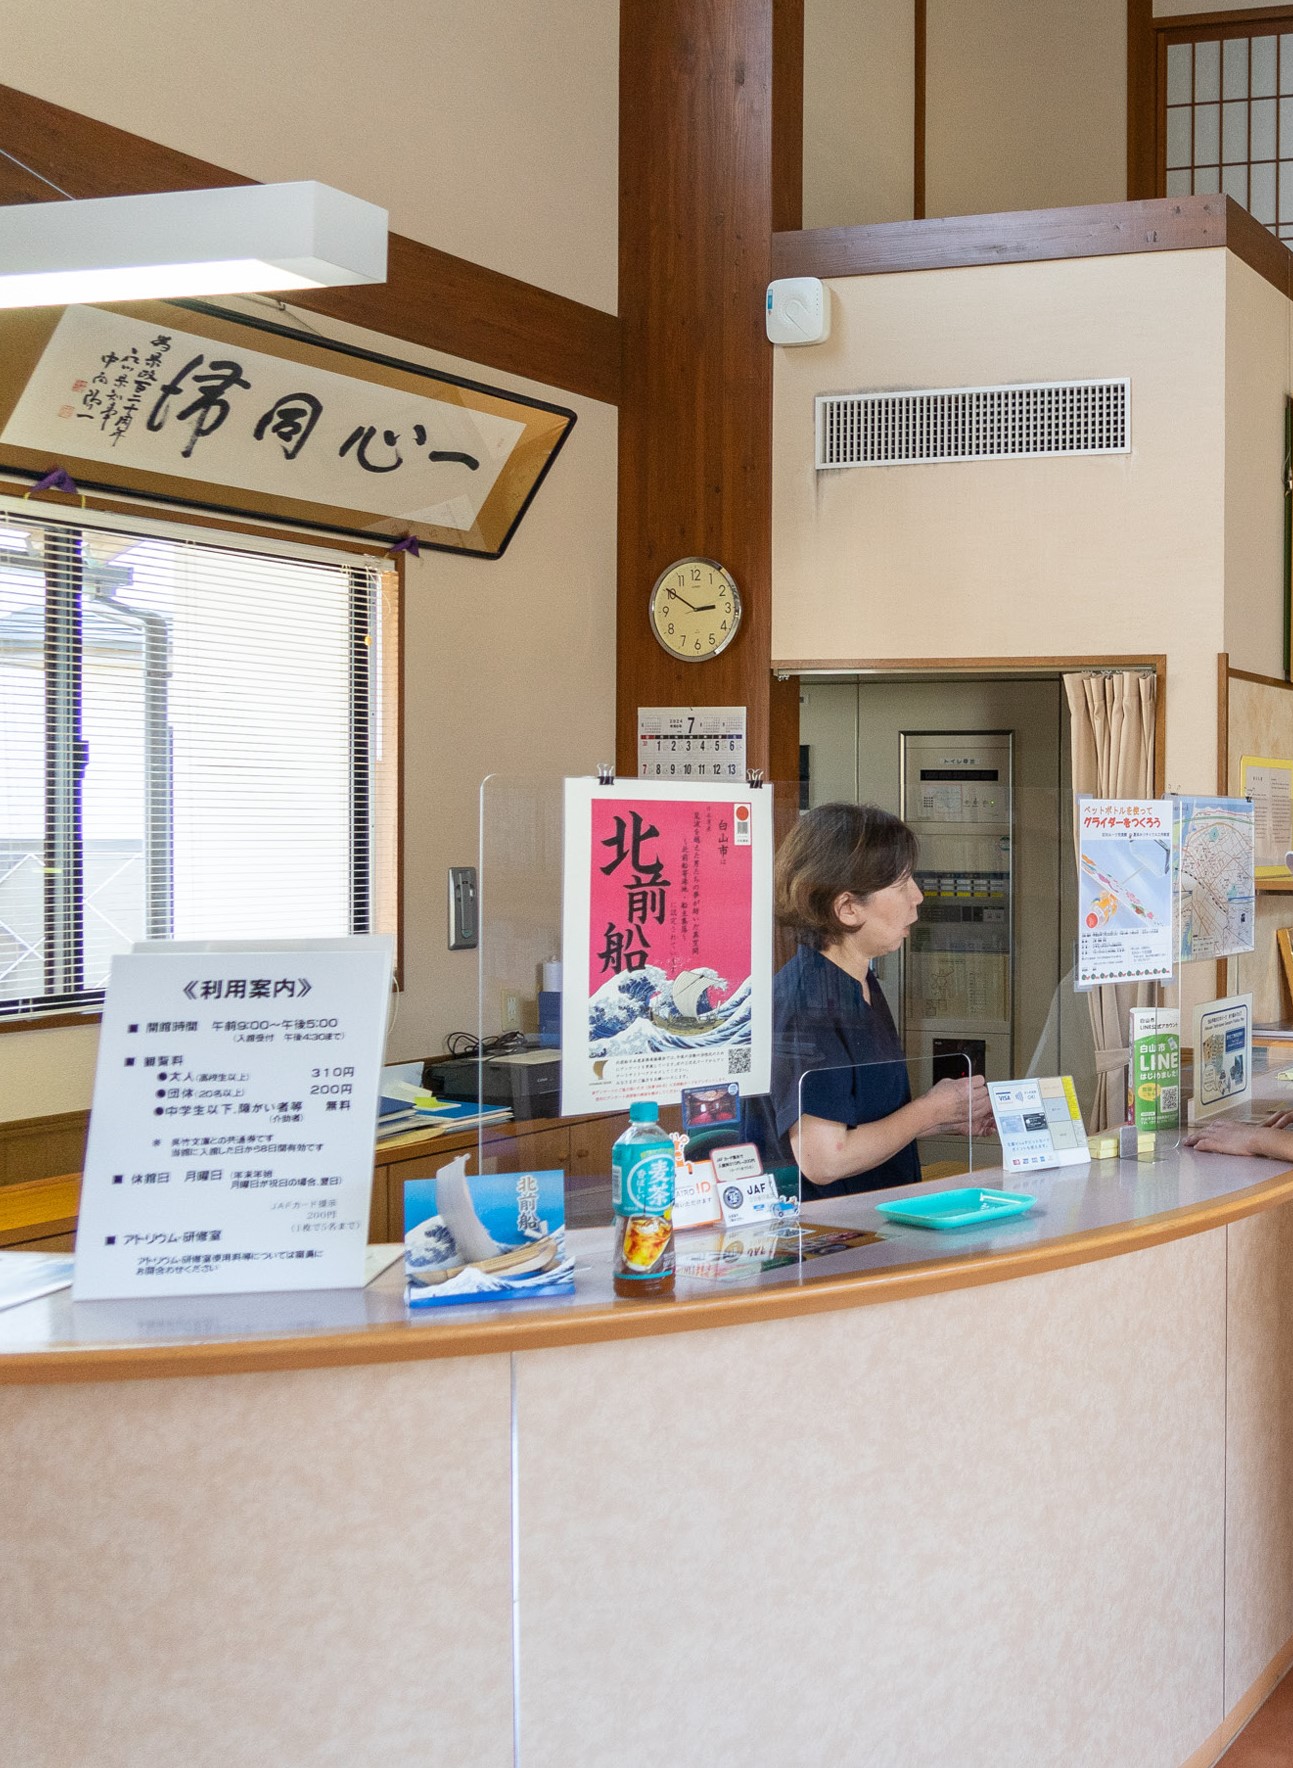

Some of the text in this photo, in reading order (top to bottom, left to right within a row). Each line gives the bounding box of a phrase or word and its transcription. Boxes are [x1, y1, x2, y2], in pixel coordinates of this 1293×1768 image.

[678, 575, 685, 587] 11
[690, 569, 701, 581] 12
[709, 573, 713, 585] 1
[667, 588, 677, 600] 10
[718, 585, 726, 597] 2
[662, 606, 670, 618] 9
[724, 602, 732, 614] 3
[667, 623, 675, 635] 8
[720, 620, 727, 631] 4
[680, 635, 687, 647] 7
[694, 639, 702, 650] 6
[708, 633, 716, 645] 5
[687, 717, 695, 733] 7
[657, 740, 661, 751] 1
[671, 740, 677, 751] 2
[686, 740, 692, 751] 3
[700, 740, 705, 751] 4
[714, 740, 720, 751] 5
[729, 740, 735, 751] 6
[642, 763, 736, 775] 7 8 9 10 11 12 13
[1084, 806, 1153, 815] ペットボトルを使って
[1083, 816, 1161, 828] グライダーをつくろう
[718, 819, 728, 865] 白山市は
[597, 810, 672, 974] 北前船
[183, 978, 312, 1000] 《利用案内》
[146, 1021, 198, 1033] 開館時間
[1140, 1043, 1166, 1053] 白山市
[1140, 1052, 1178, 1071] LINE
[311, 1066, 355, 1078] 310円
[310, 1083, 353, 1095] 200円
[325, 1100, 351, 1112] 無料
[131, 1171, 170, 1184] 休館日
[184, 1169, 223, 1182] 月曜日
[645, 1159, 671, 1206] 麦茶
[747, 1183, 766, 1195] JAF
[518, 1176, 538, 1230] 北前船
